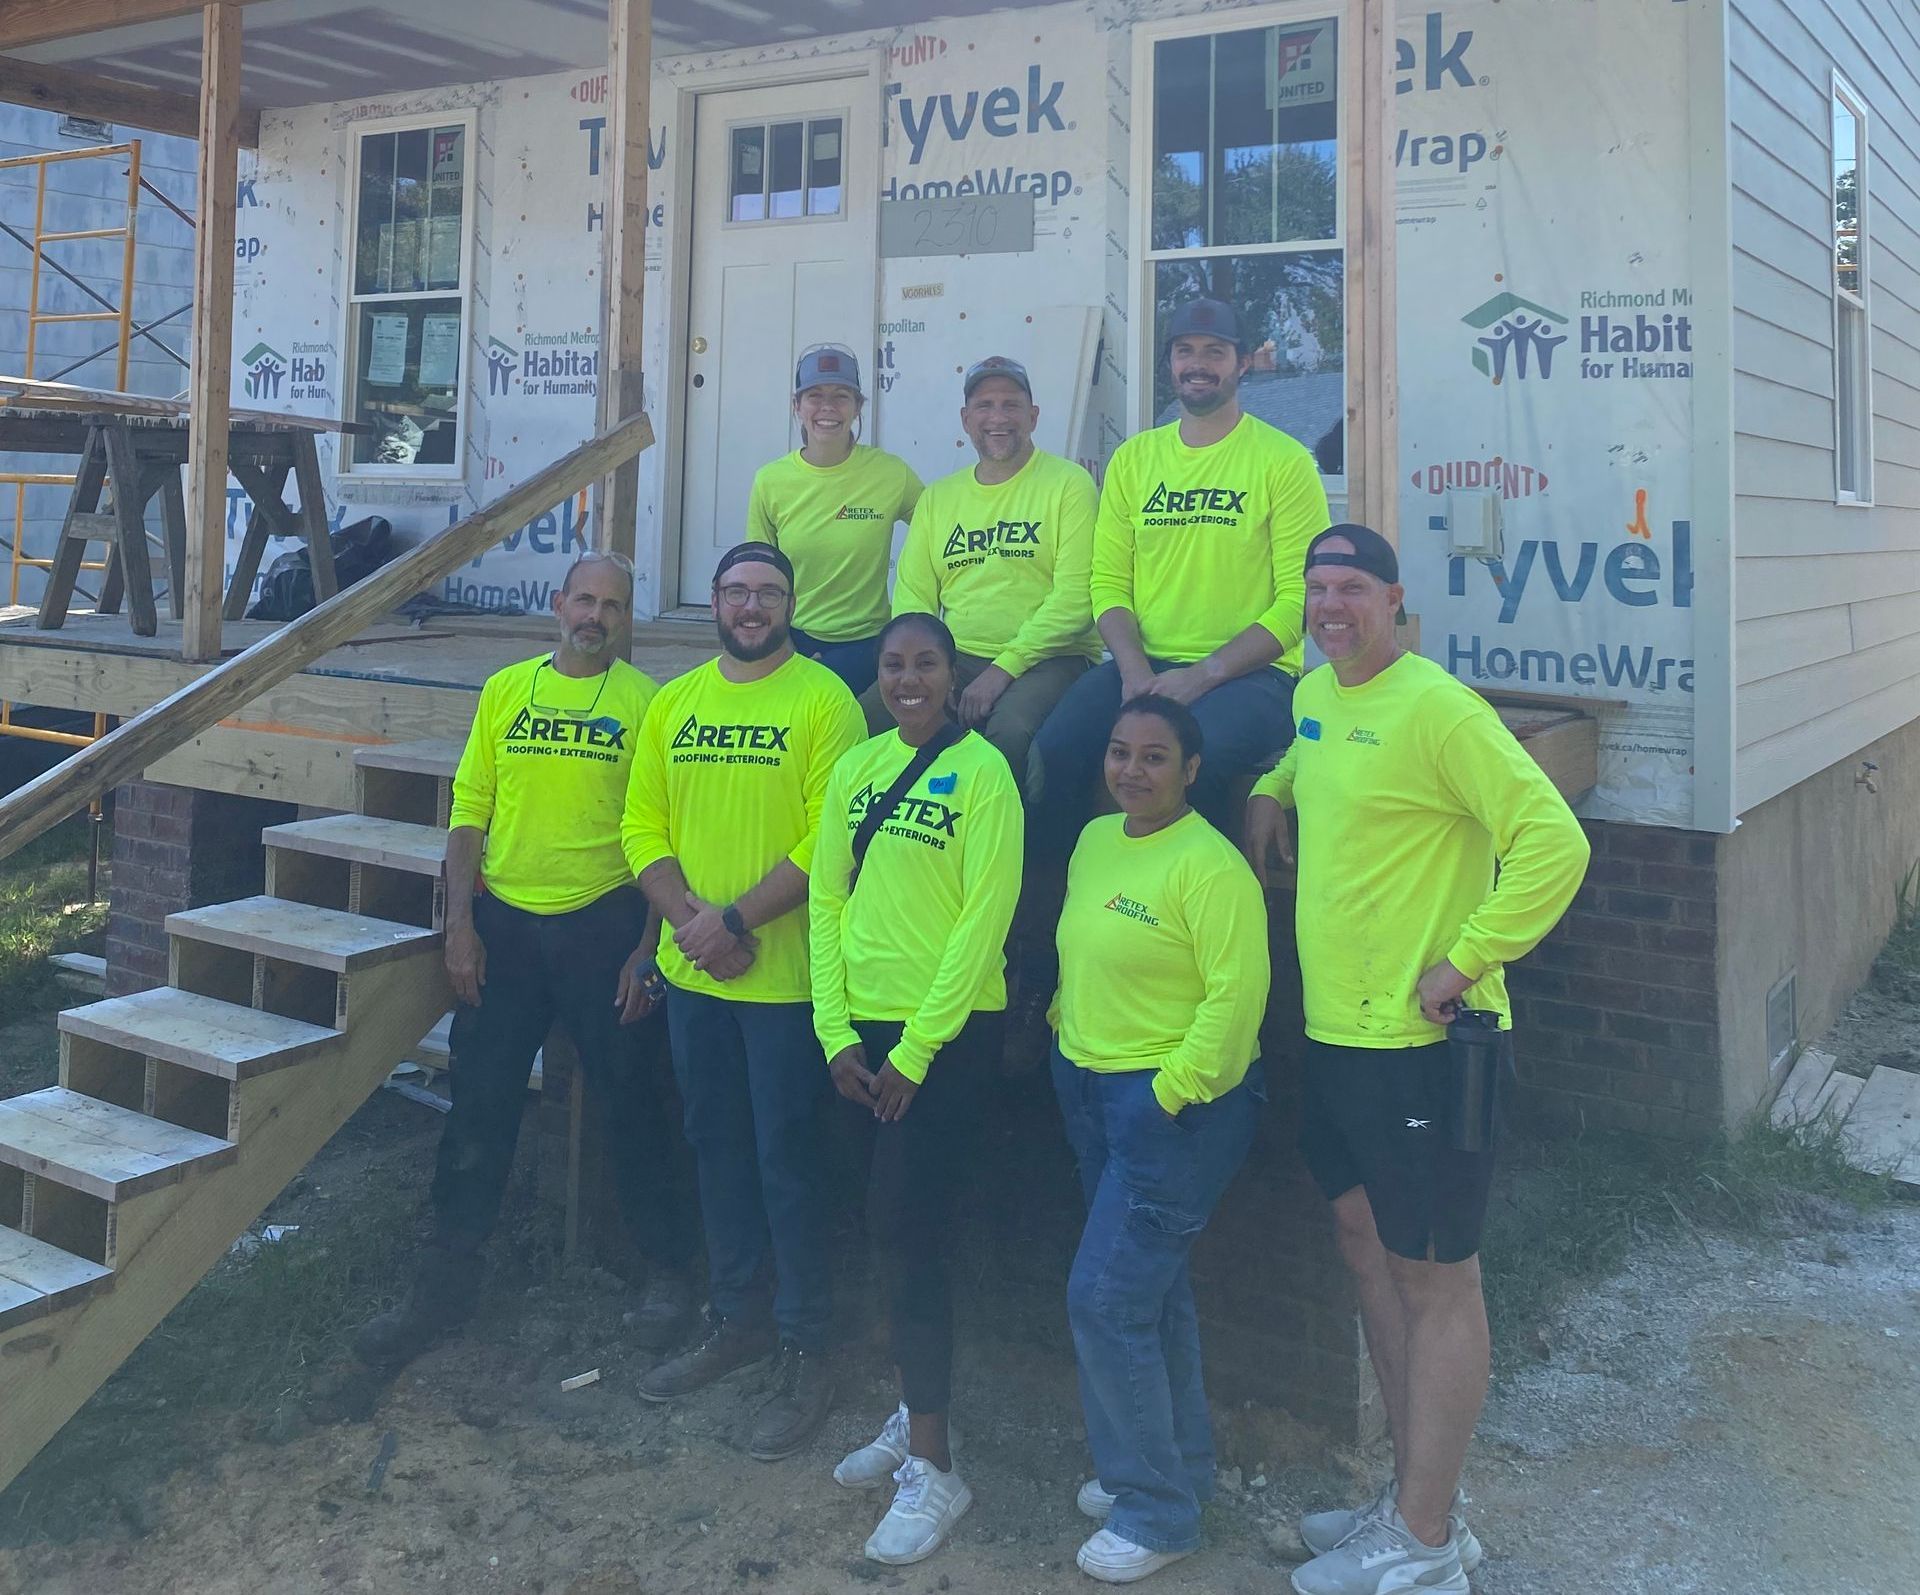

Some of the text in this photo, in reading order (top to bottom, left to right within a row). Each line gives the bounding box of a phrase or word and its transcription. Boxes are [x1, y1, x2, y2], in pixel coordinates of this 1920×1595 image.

[1581, 288, 1665, 309] Richmond
[524, 331, 567, 346] Richmond
[1581, 314, 1692, 353] Habit
[291, 341, 328, 354] Richmond
[291, 357, 325, 382] Hab
[1581, 357, 1693, 379] for Huma
[291, 385, 304, 399] for
[523, 380, 538, 395] for
[1115, 904, 1160, 927] ROOFING
